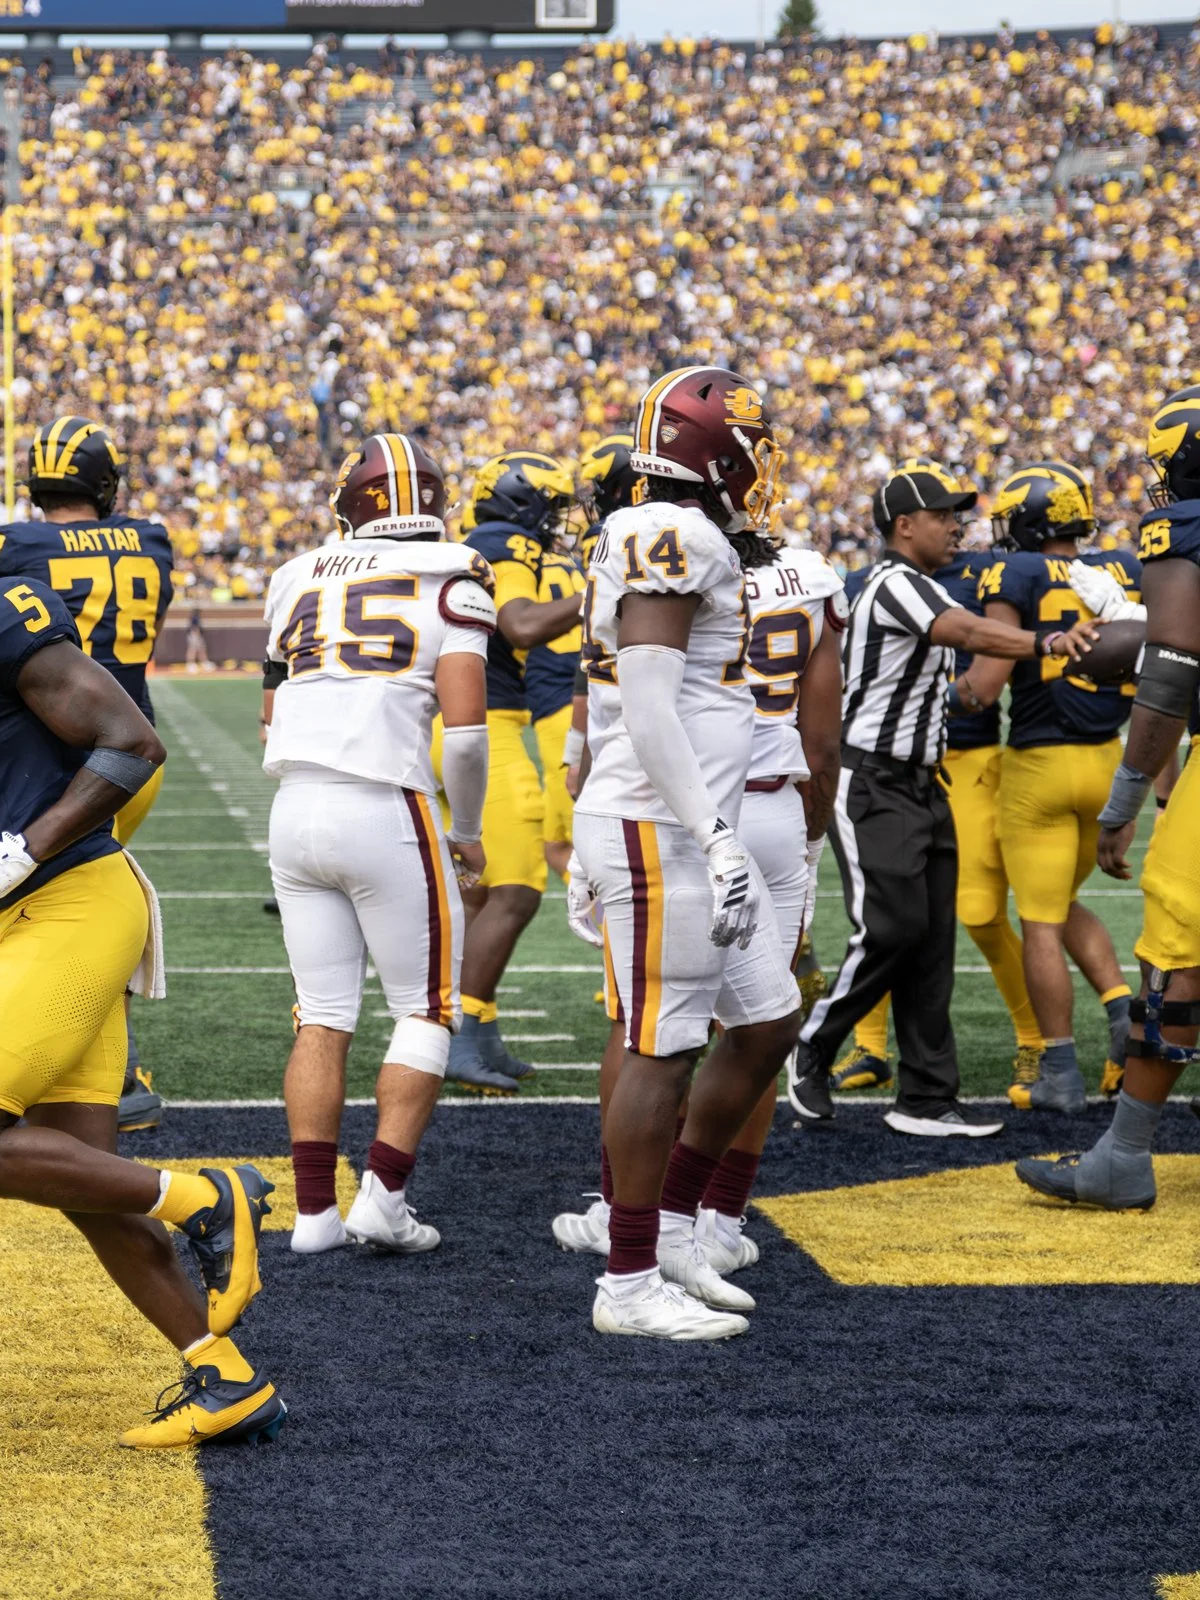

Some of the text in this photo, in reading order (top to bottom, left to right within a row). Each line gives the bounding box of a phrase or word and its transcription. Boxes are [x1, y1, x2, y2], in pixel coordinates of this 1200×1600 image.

[60, 528, 142, 552] HATTAR
[374, 521, 435, 532] DEROMEDI
[1137, 518, 1171, 559] 55
[312, 553, 379, 579] WHITE
[622, 527, 688, 583] 14
[775, 568, 810, 597] JR.
[3, 584, 51, 633] 5
[48, 555, 161, 665] 78
[277, 575, 420, 678] 45
